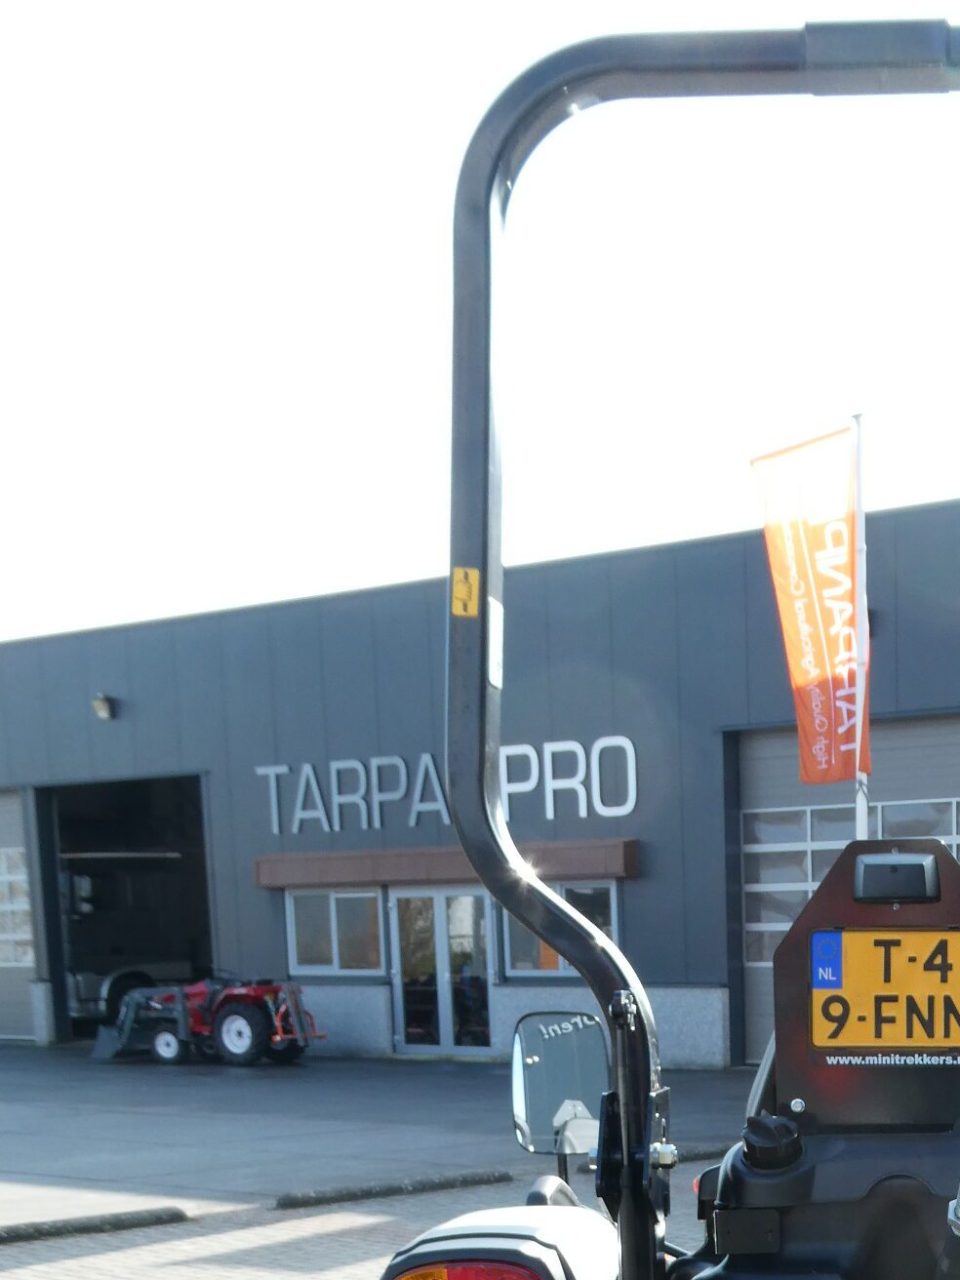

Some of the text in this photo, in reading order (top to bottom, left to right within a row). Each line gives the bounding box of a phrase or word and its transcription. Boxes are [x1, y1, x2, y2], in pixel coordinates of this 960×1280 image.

[254, 735, 637, 836] TARPAPRO
[818, 967, 837, 981] NL
[873, 938, 953, 984] T-4
